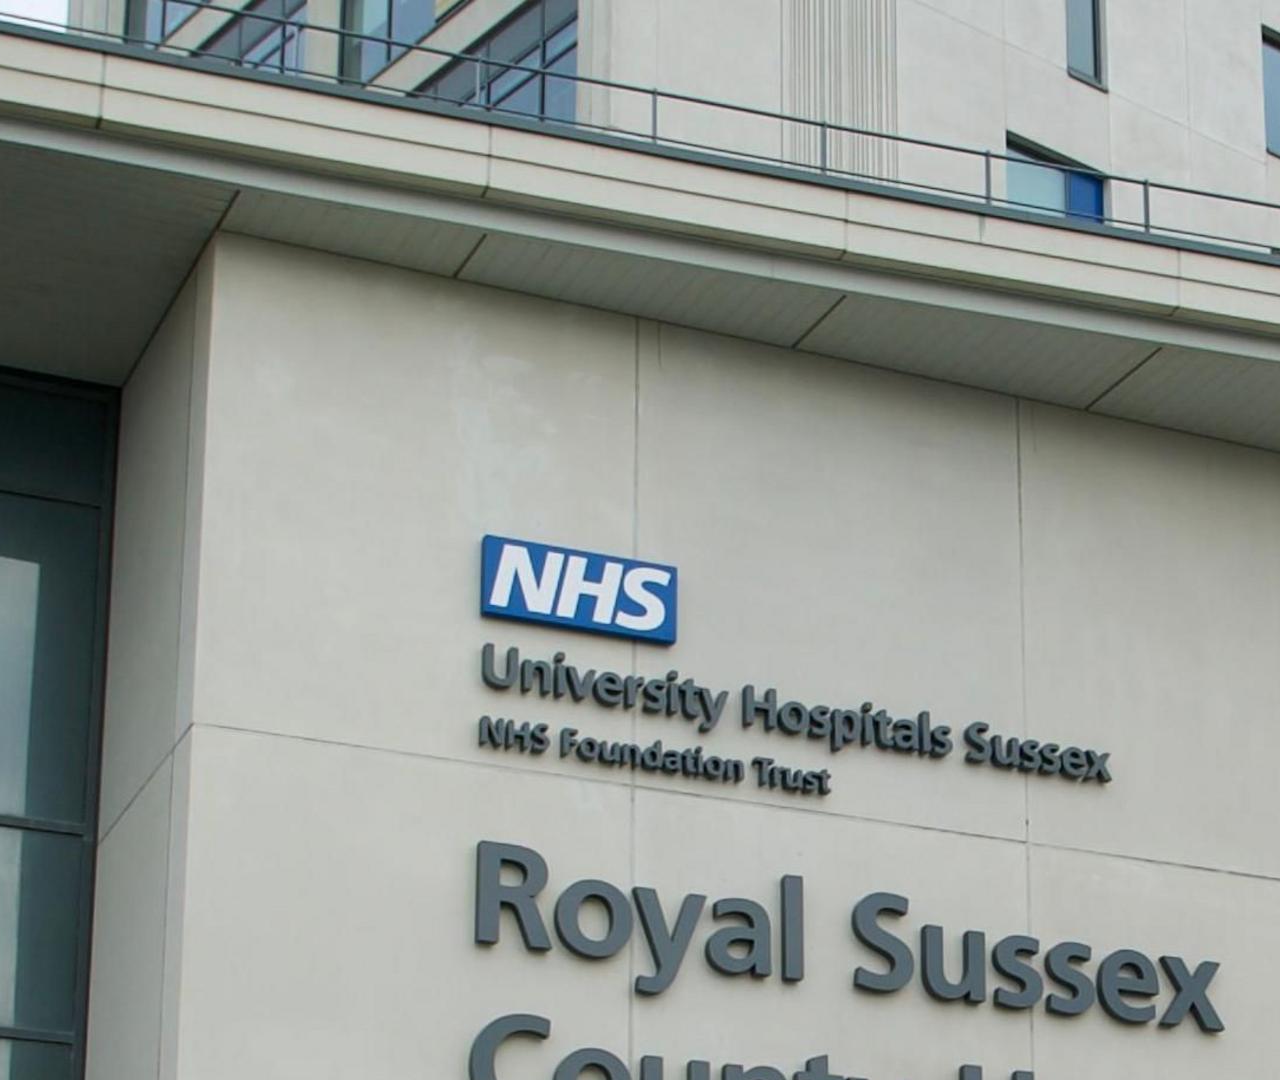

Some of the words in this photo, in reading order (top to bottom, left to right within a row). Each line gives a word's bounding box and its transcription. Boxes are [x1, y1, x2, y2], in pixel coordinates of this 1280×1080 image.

[488, 544, 672, 633] NHS
[478, 716, 549, 754] NHS
[560, 728, 744, 784] Foundation
[752, 758, 831, 797] Trust
[482, 643, 728, 732] University
[741, 684, 953, 759] Hospitals
[964, 722, 1112, 784] Sussex
[474, 839, 805, 997] Royal
[851, 890, 1226, 1035] Sussex
